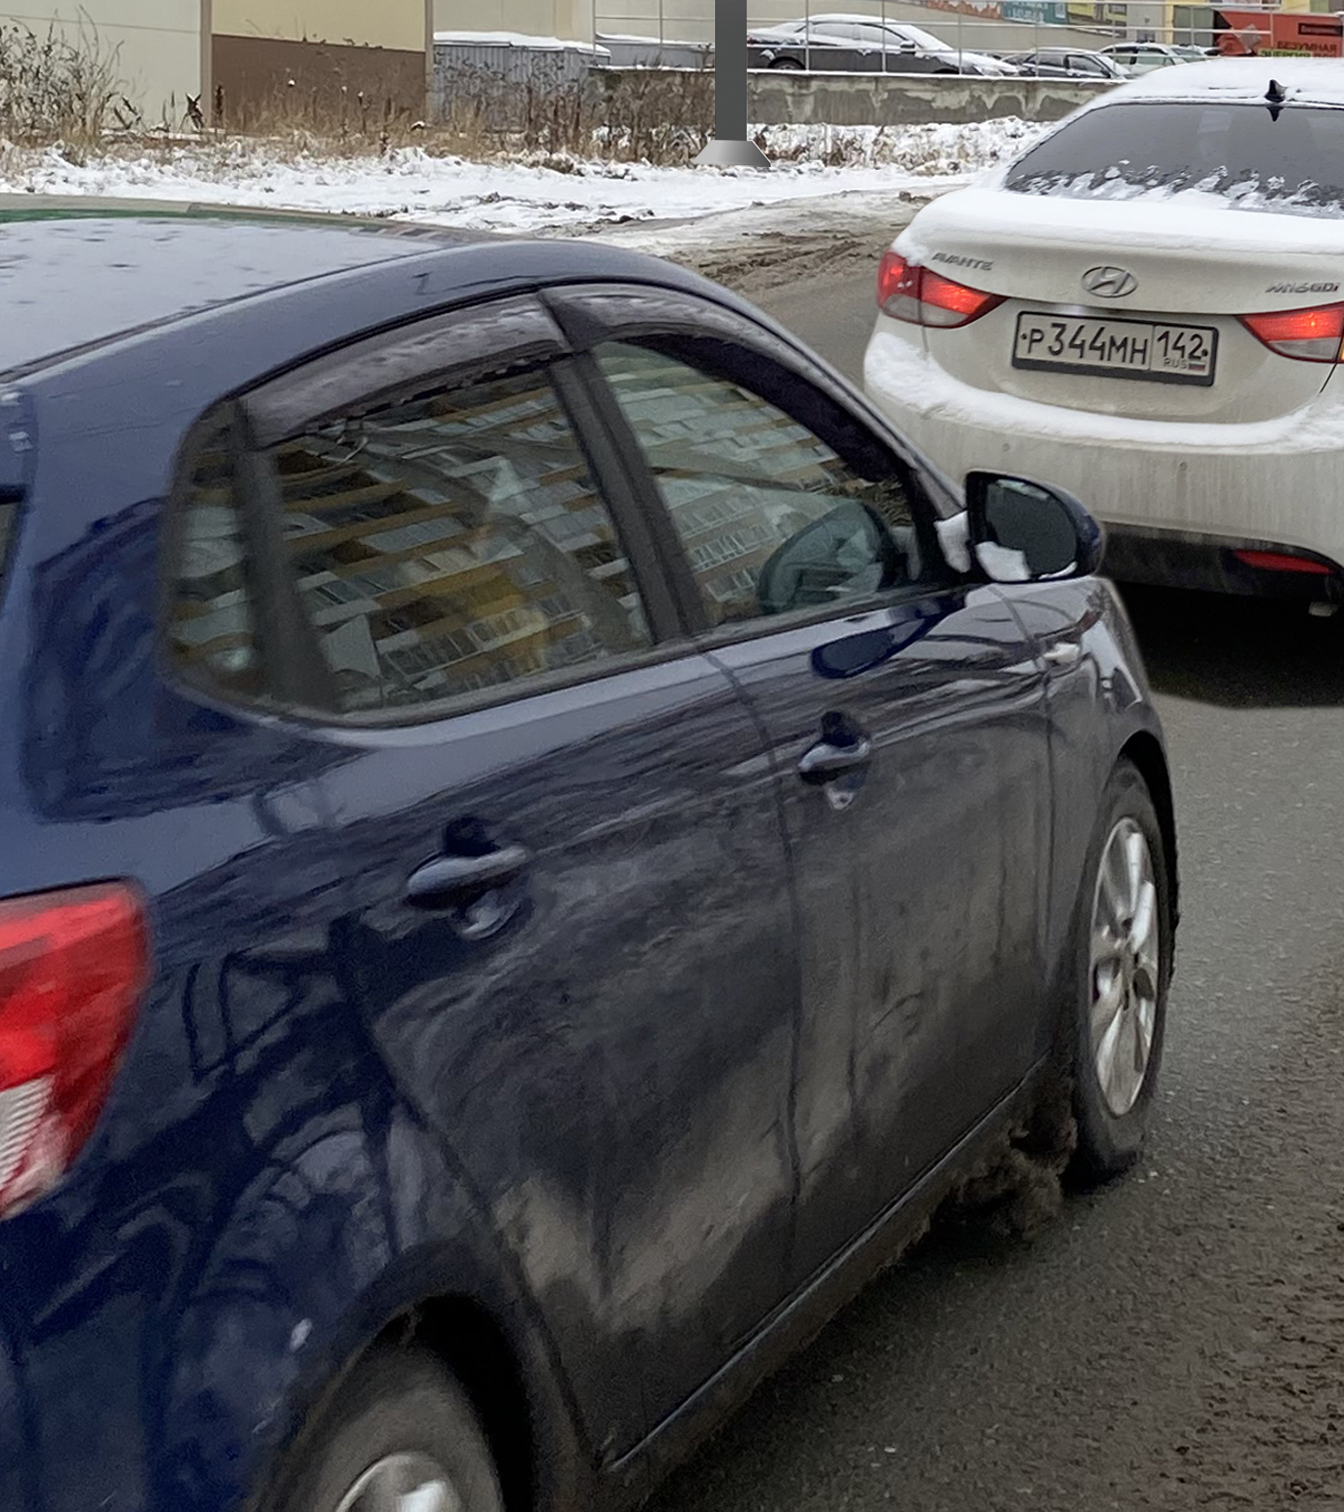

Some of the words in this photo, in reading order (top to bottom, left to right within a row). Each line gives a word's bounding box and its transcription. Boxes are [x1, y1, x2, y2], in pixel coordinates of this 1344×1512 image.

[932, 252, 994, 271] AVANTE
[1157, 330, 1205, 360] 142
[1163, 356, 1188, 369] RUS
